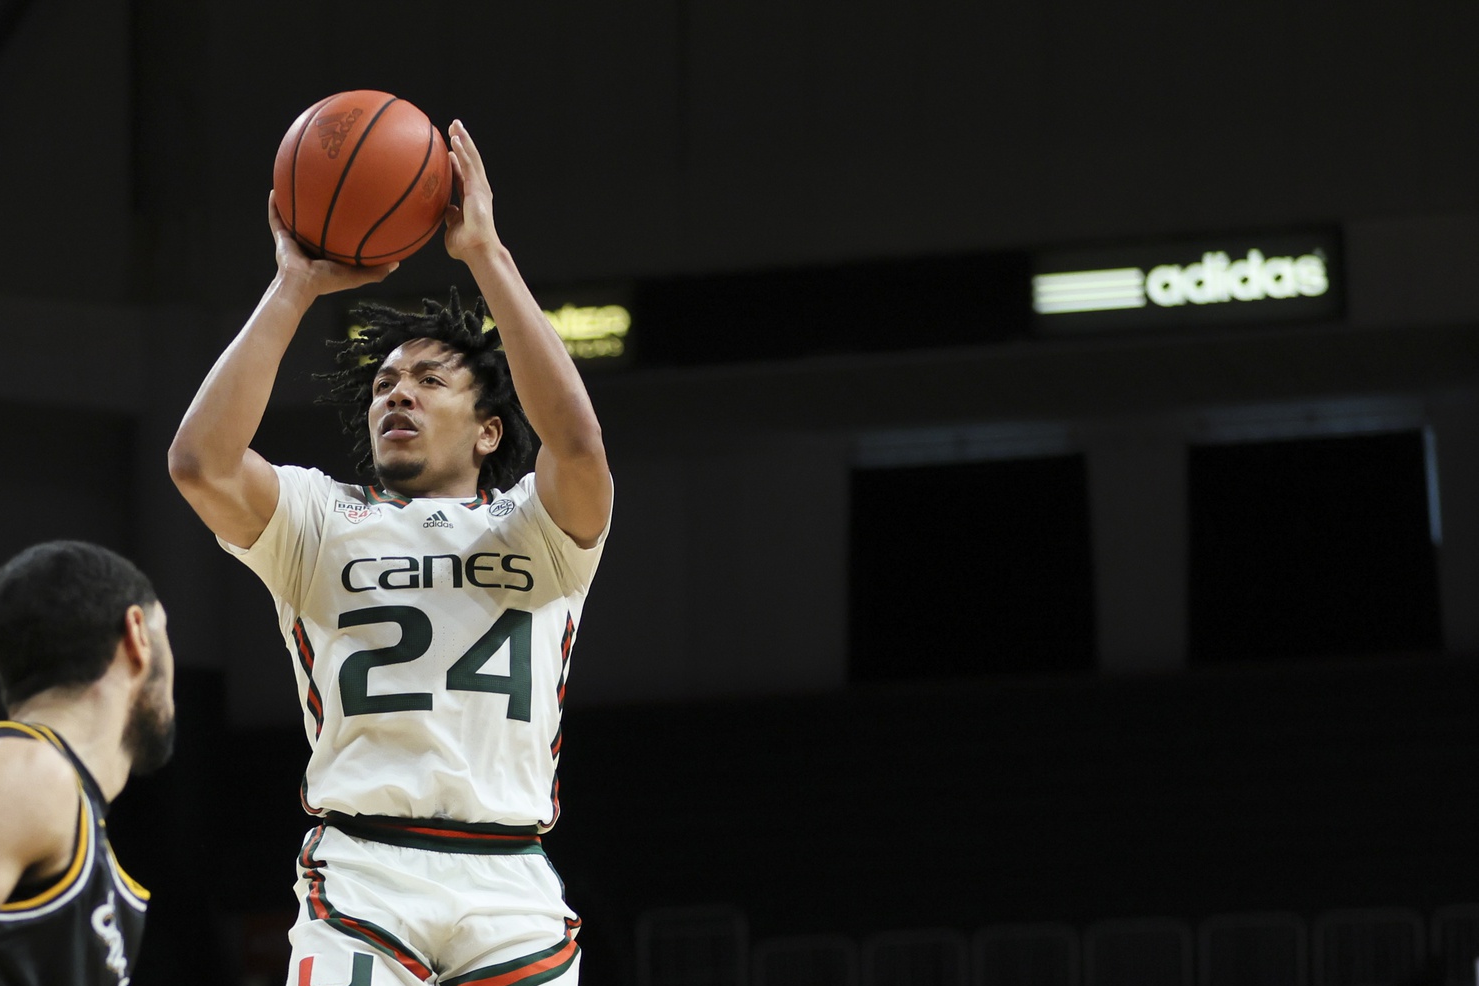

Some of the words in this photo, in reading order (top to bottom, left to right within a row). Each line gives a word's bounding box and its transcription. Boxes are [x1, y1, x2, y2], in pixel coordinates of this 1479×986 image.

[1145, 249, 1329, 307] adidas
[348, 510, 369, 519] 24
[422, 520, 454, 529] adidas
[338, 605, 532, 723] 24
